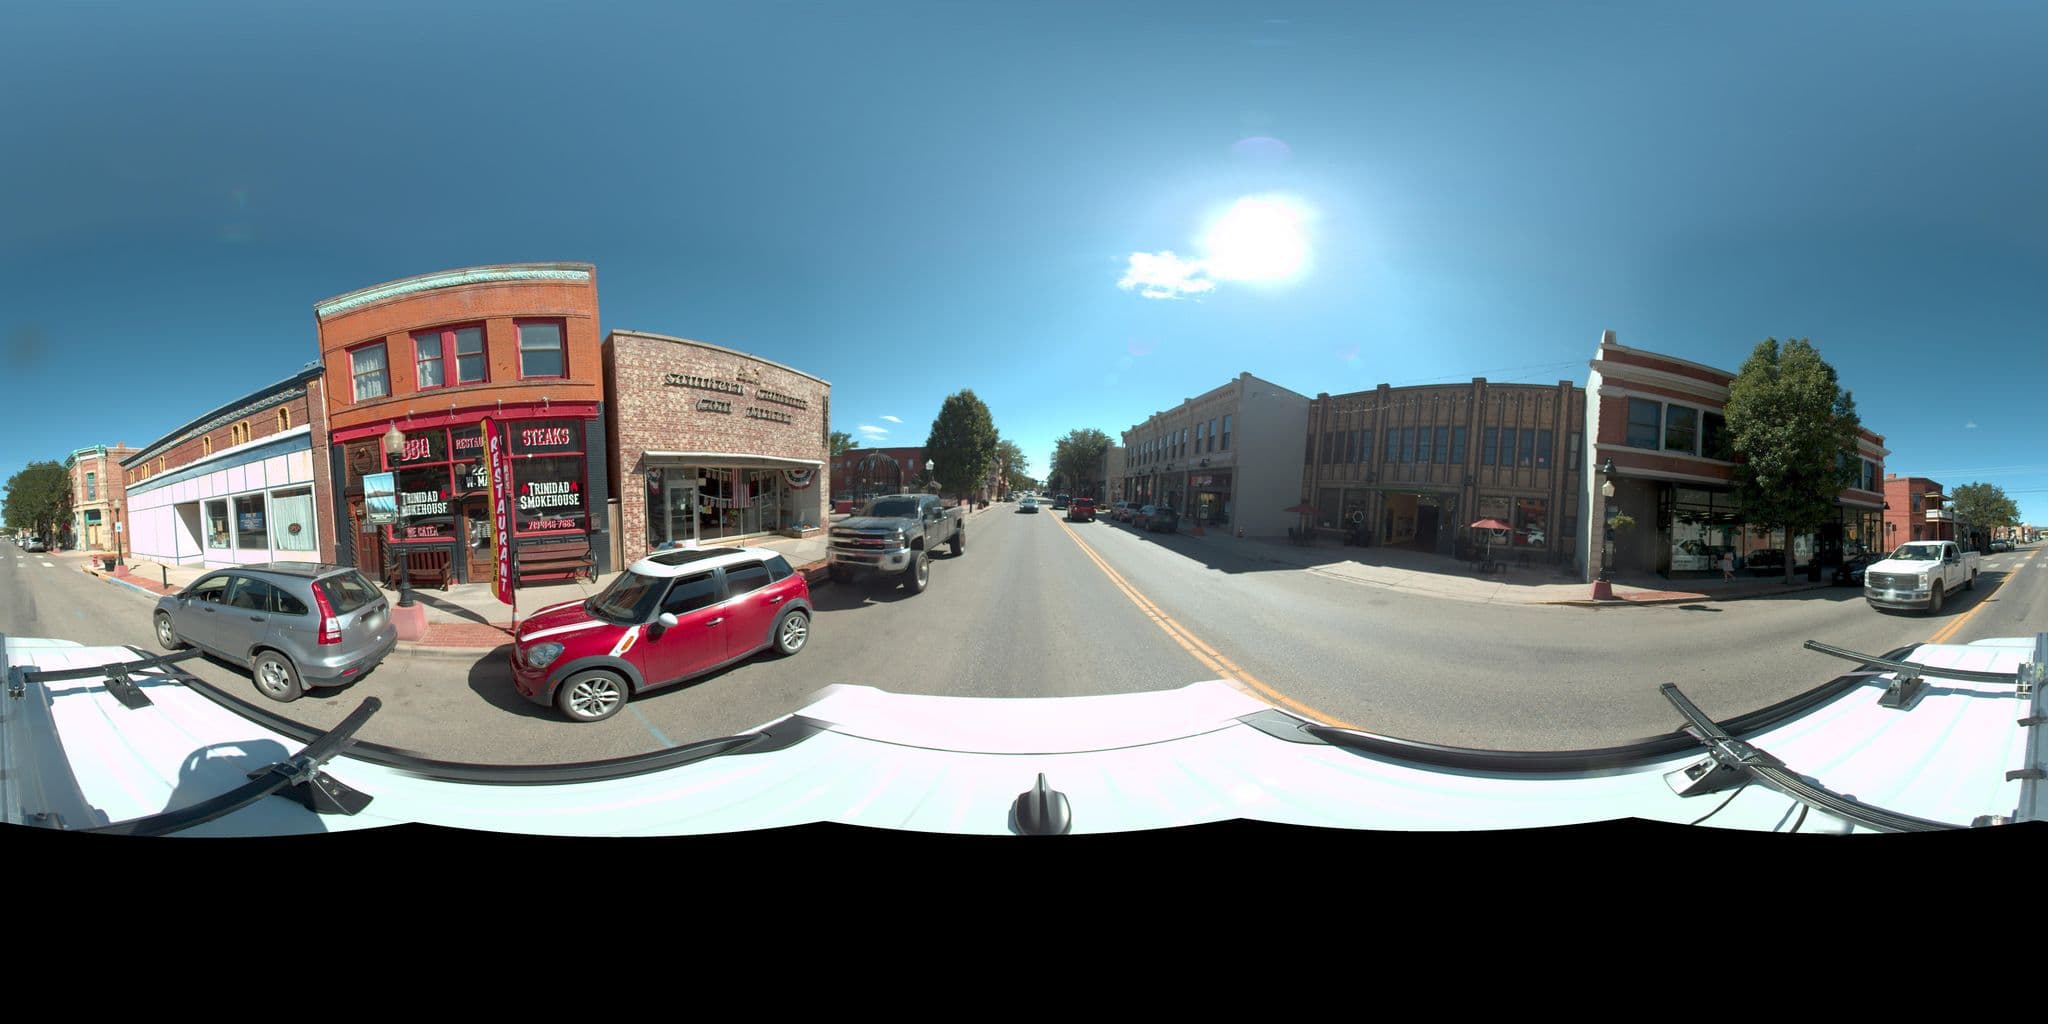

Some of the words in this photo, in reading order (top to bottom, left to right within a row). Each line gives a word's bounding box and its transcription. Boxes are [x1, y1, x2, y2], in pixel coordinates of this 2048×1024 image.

[522, 427, 570, 446] STEAKS
[528, 481, 570, 497] TRINIDAD
[400, 502, 448, 517] MOKEHOUSE
[520, 493, 580, 510] SMOKEHOUSE
[490, 436, 509, 592] RESTAURANT
